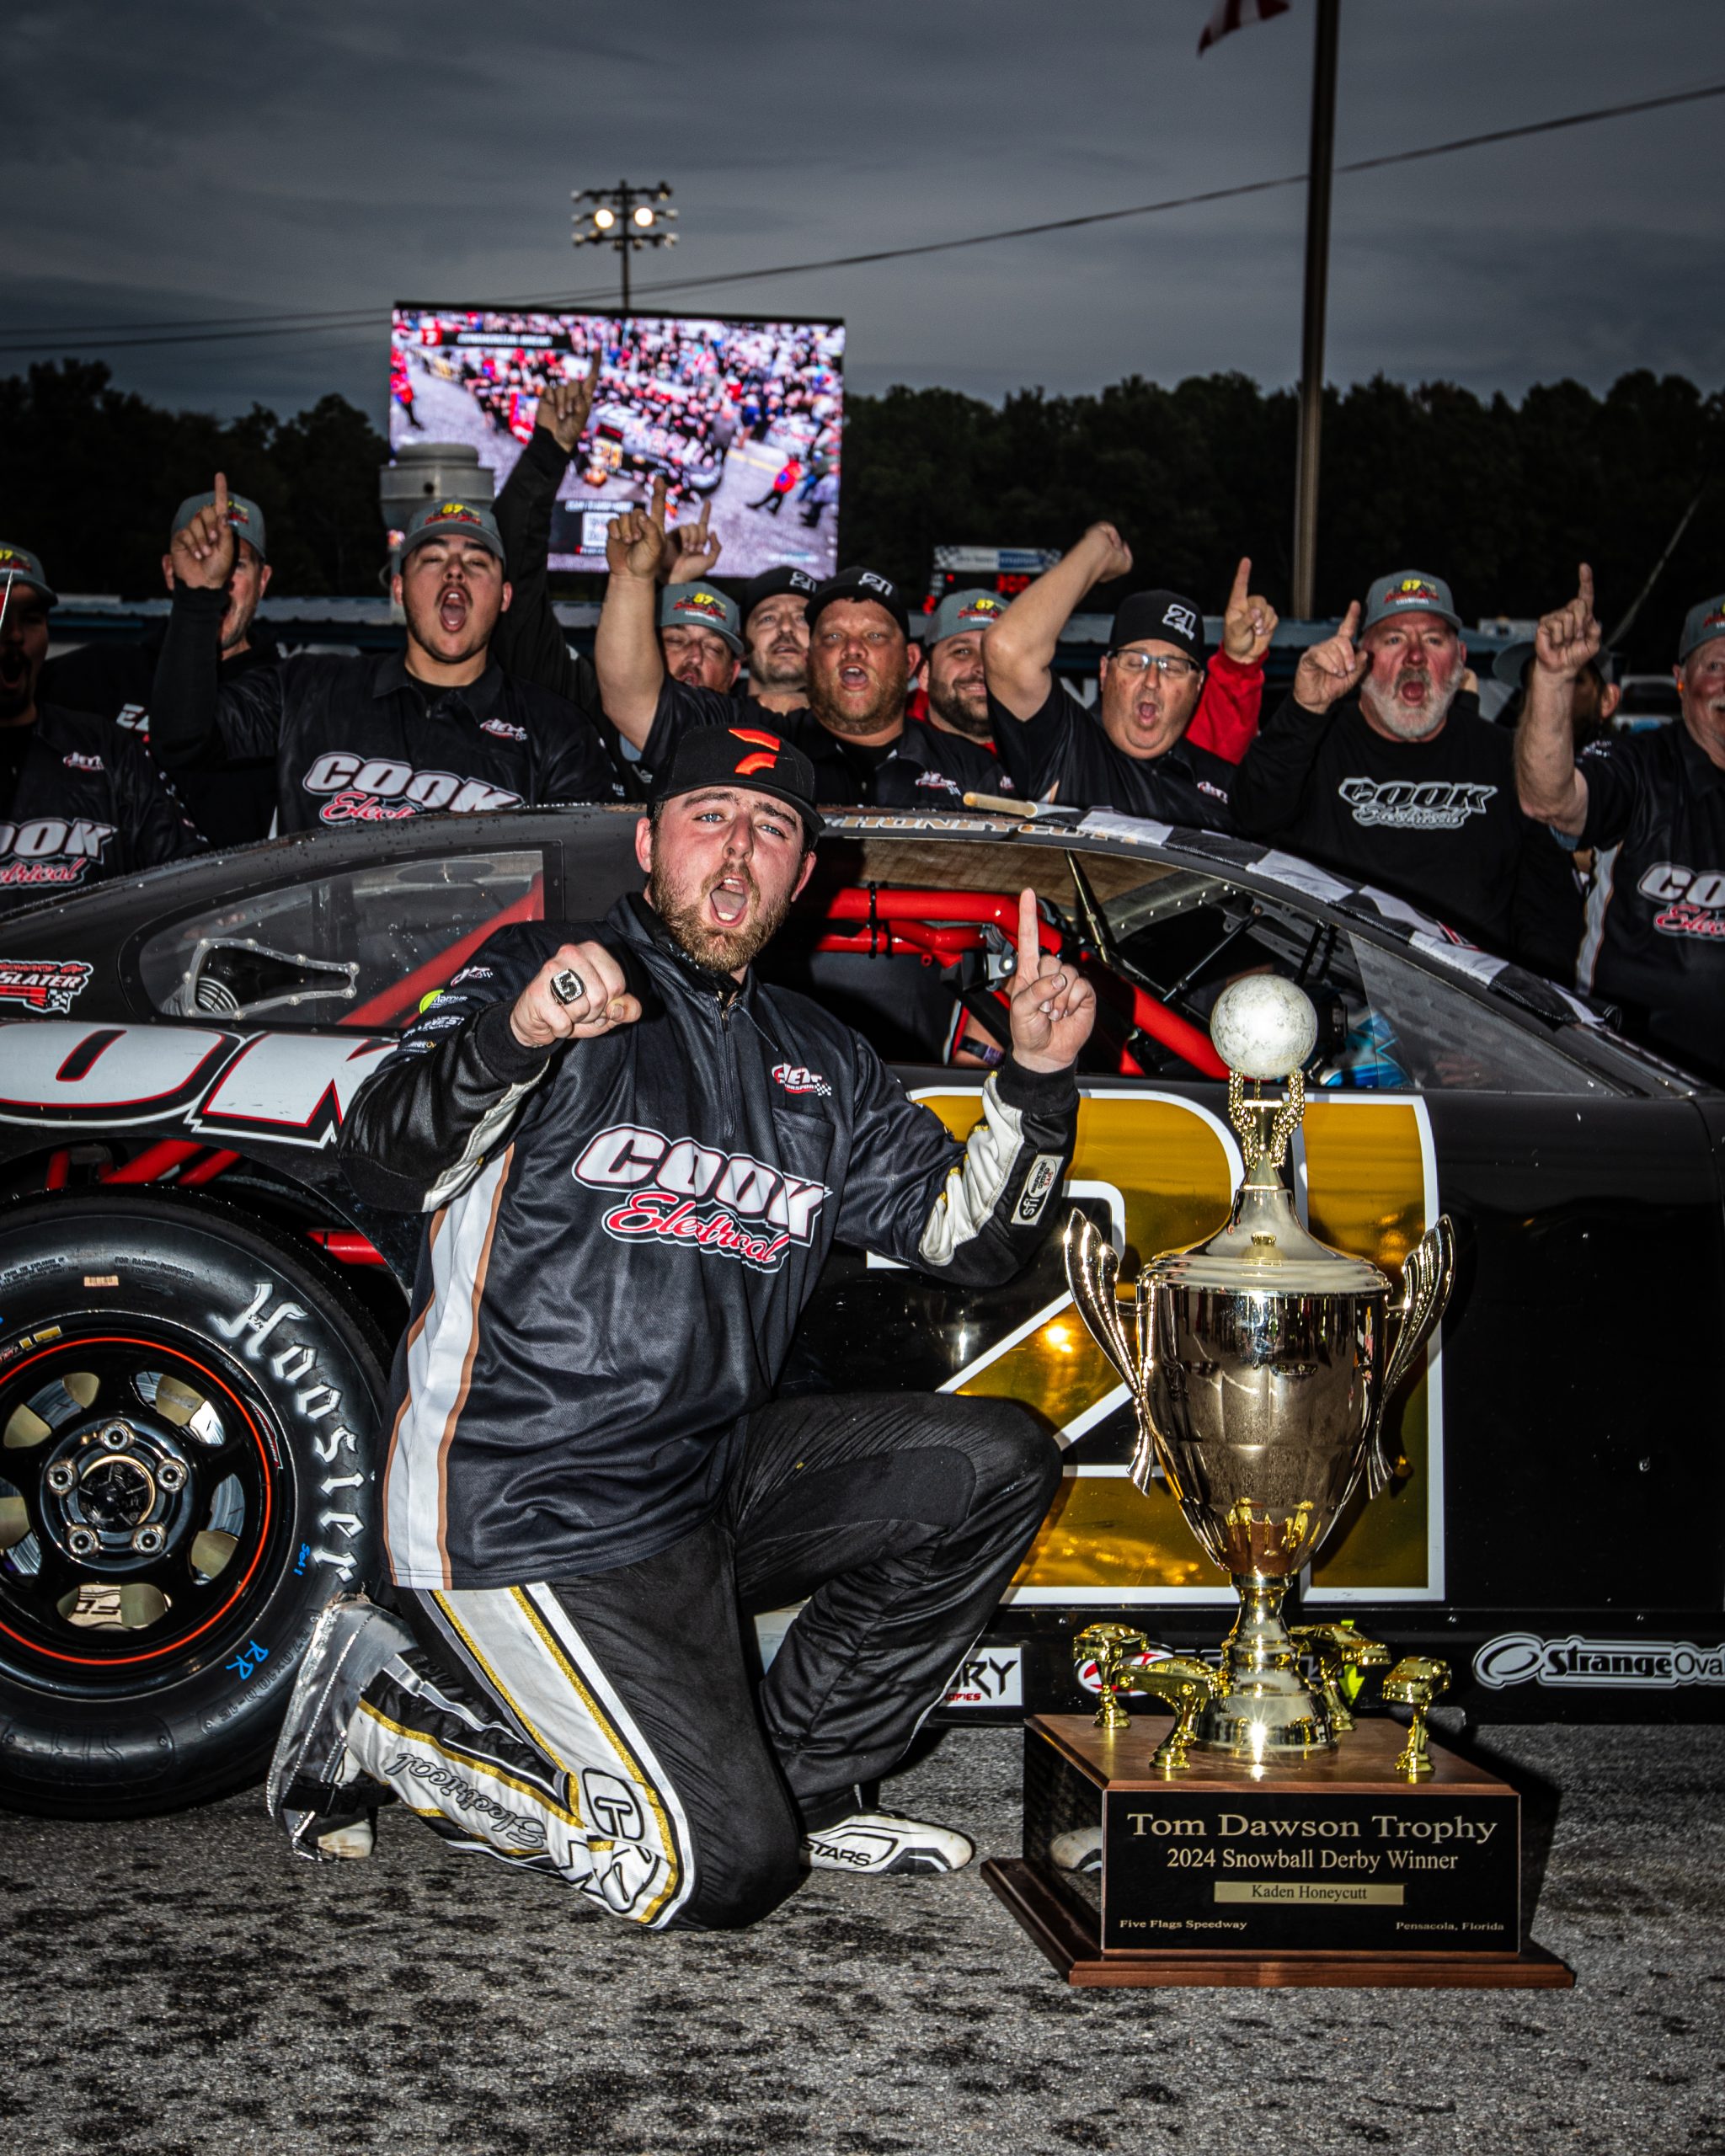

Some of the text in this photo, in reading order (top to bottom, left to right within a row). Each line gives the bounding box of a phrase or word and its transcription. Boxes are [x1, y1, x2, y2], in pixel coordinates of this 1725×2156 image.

[304, 753, 523, 812] COOK
[1339, 777, 1498, 814] COOK
[841, 815, 1140, 845] HONEYCU
[574, 1126, 827, 1240] COOK
[132, 1258, 158, 1268] RACING
[160, 1262, 195, 1279] PURPOSES
[225, 1639, 270, 1681] RR
[1546, 1645, 1673, 1678] Strange
[384, 1753, 547, 1849] Electrical
[1127, 1813, 1498, 1844] Tom Dawson Trophy
[1167, 1848, 1459, 1874] 2024 Snowball Derby Winner
[1252, 1884, 1368, 1903] Kaden Honeycutt
[1119, 1919, 1247, 1930] Five Flags Speedway
[1396, 1921, 1504, 1931] Pensacola, Florida
